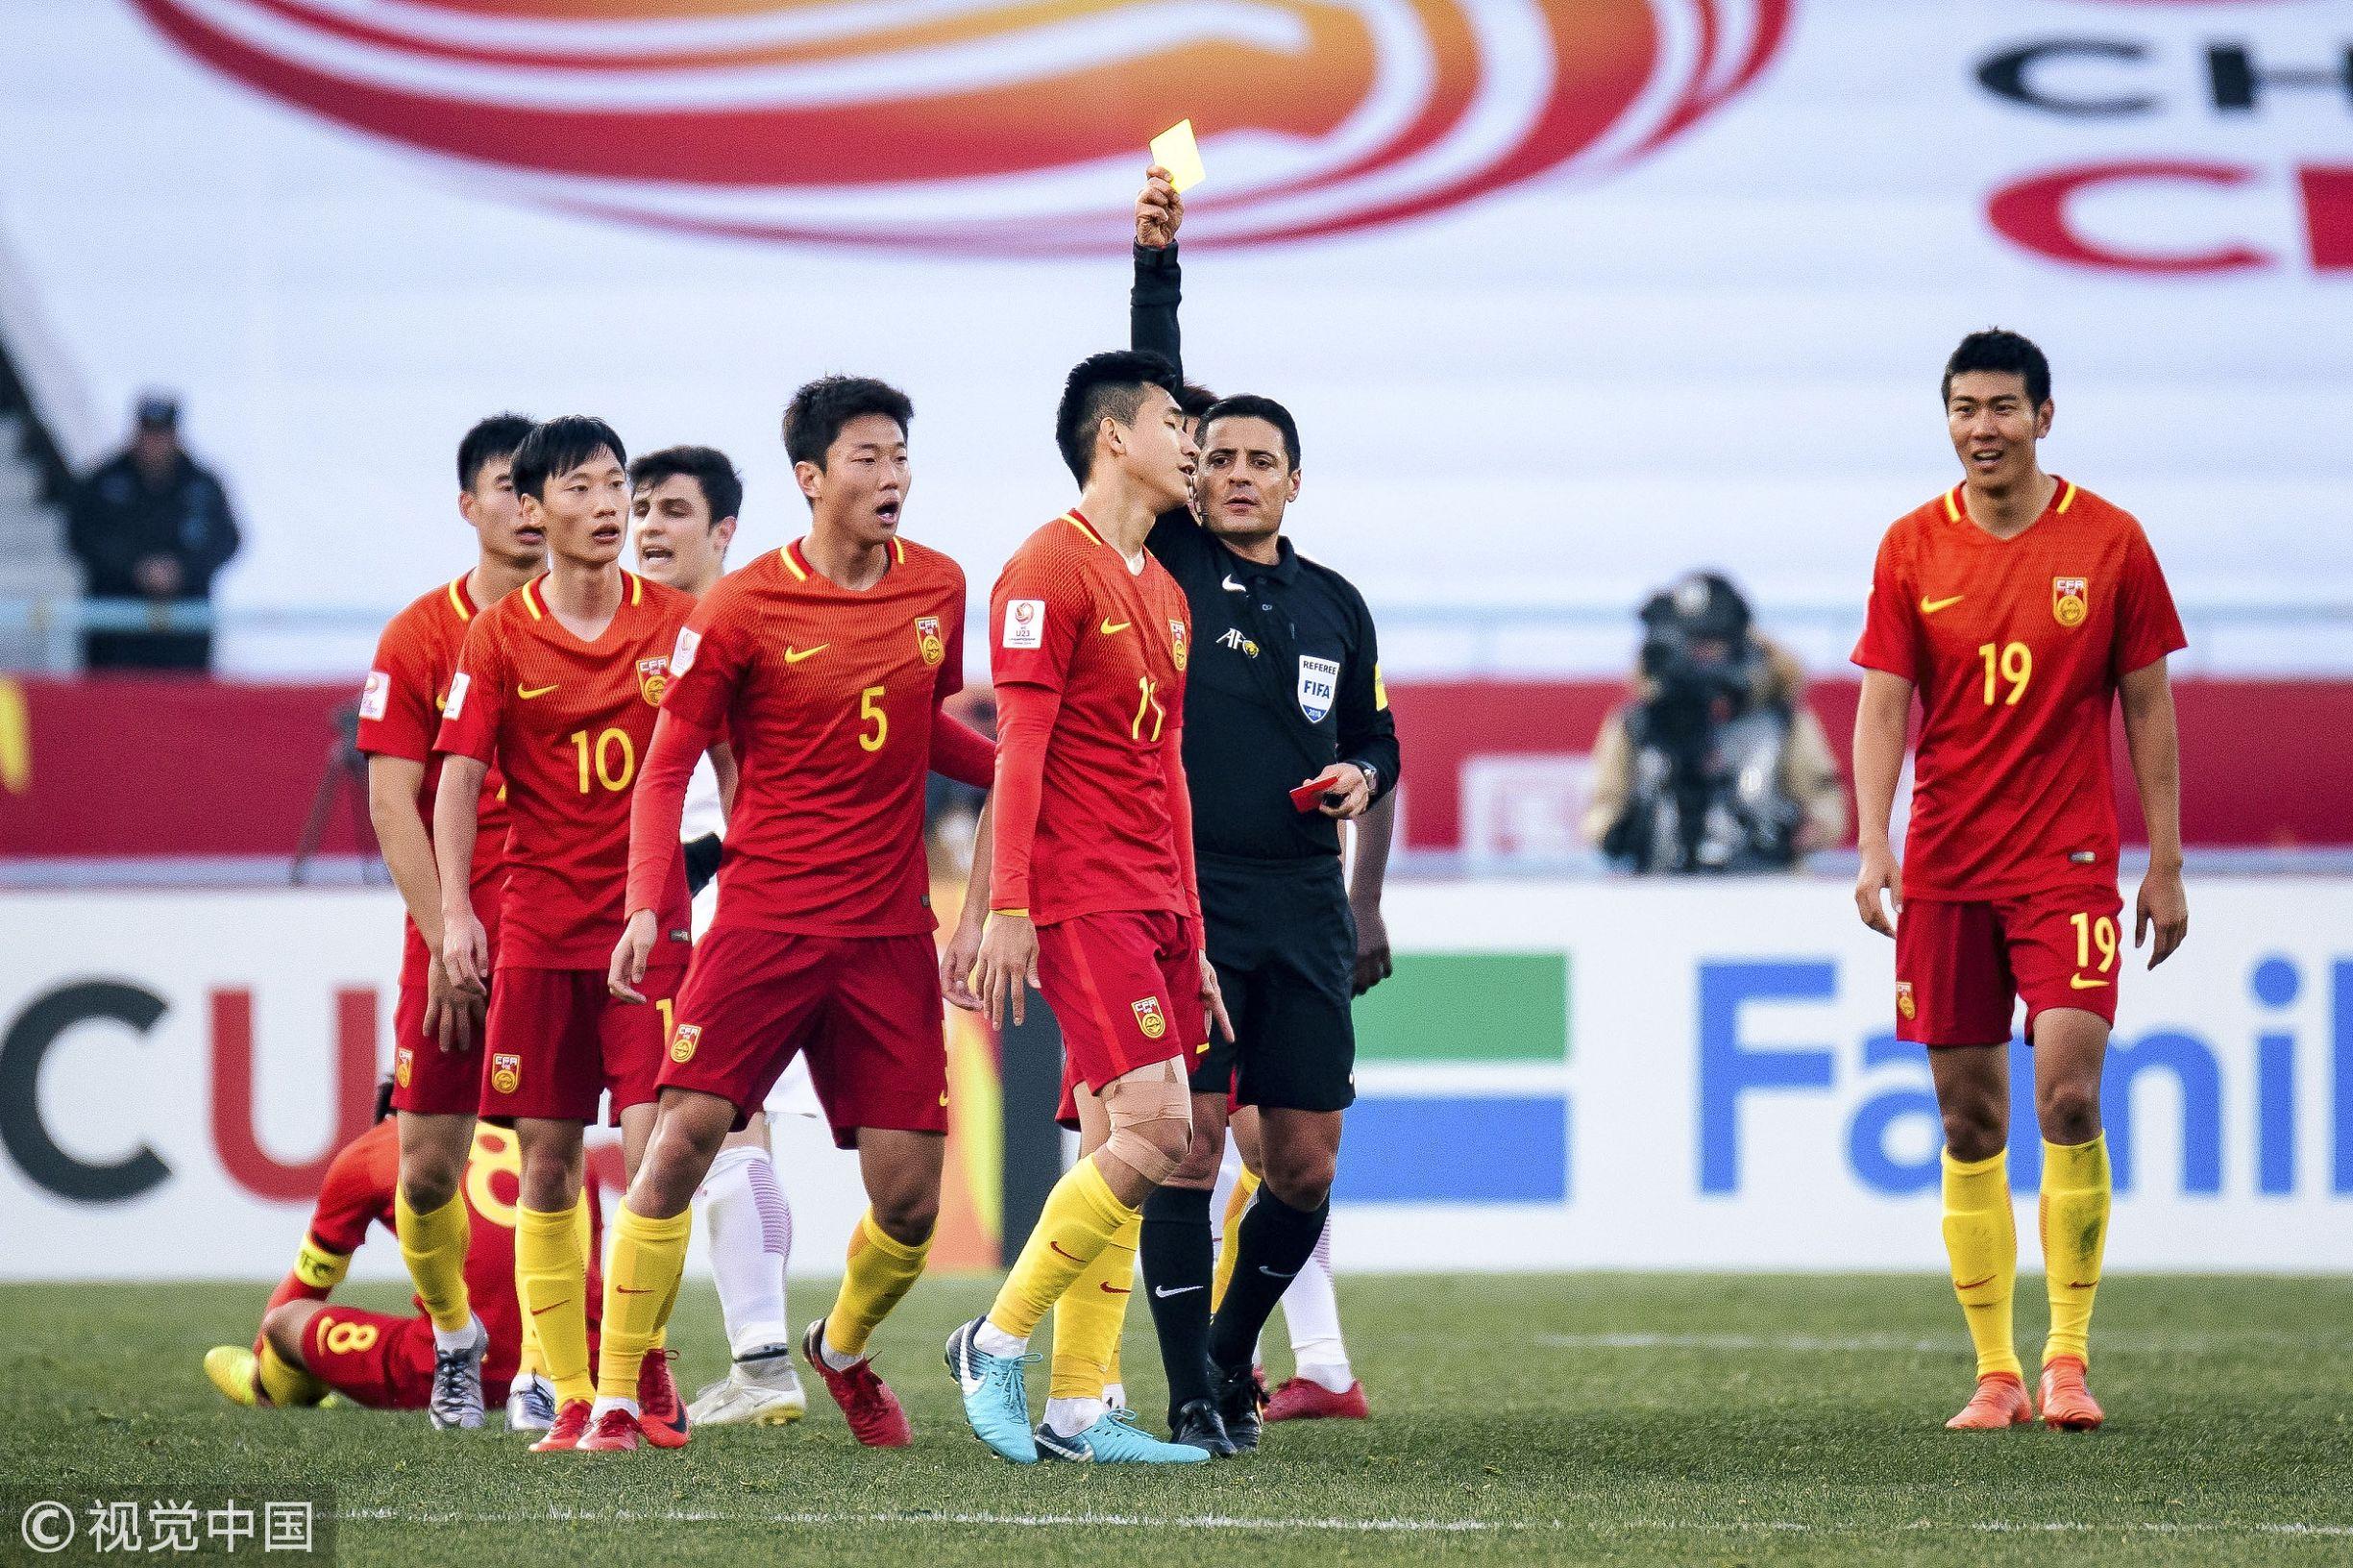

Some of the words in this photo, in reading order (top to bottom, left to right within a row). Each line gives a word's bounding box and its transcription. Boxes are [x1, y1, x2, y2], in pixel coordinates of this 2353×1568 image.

[1303, 660, 1336, 675] REFEREE
[1304, 679, 1330, 699] FIFA
[1978, 641, 2032, 705] 19
[859, 686, 889, 752] 5
[571, 727, 635, 794] 10
[2070, 912, 2116, 973] 19
[327, 1321, 378, 1356] 8
